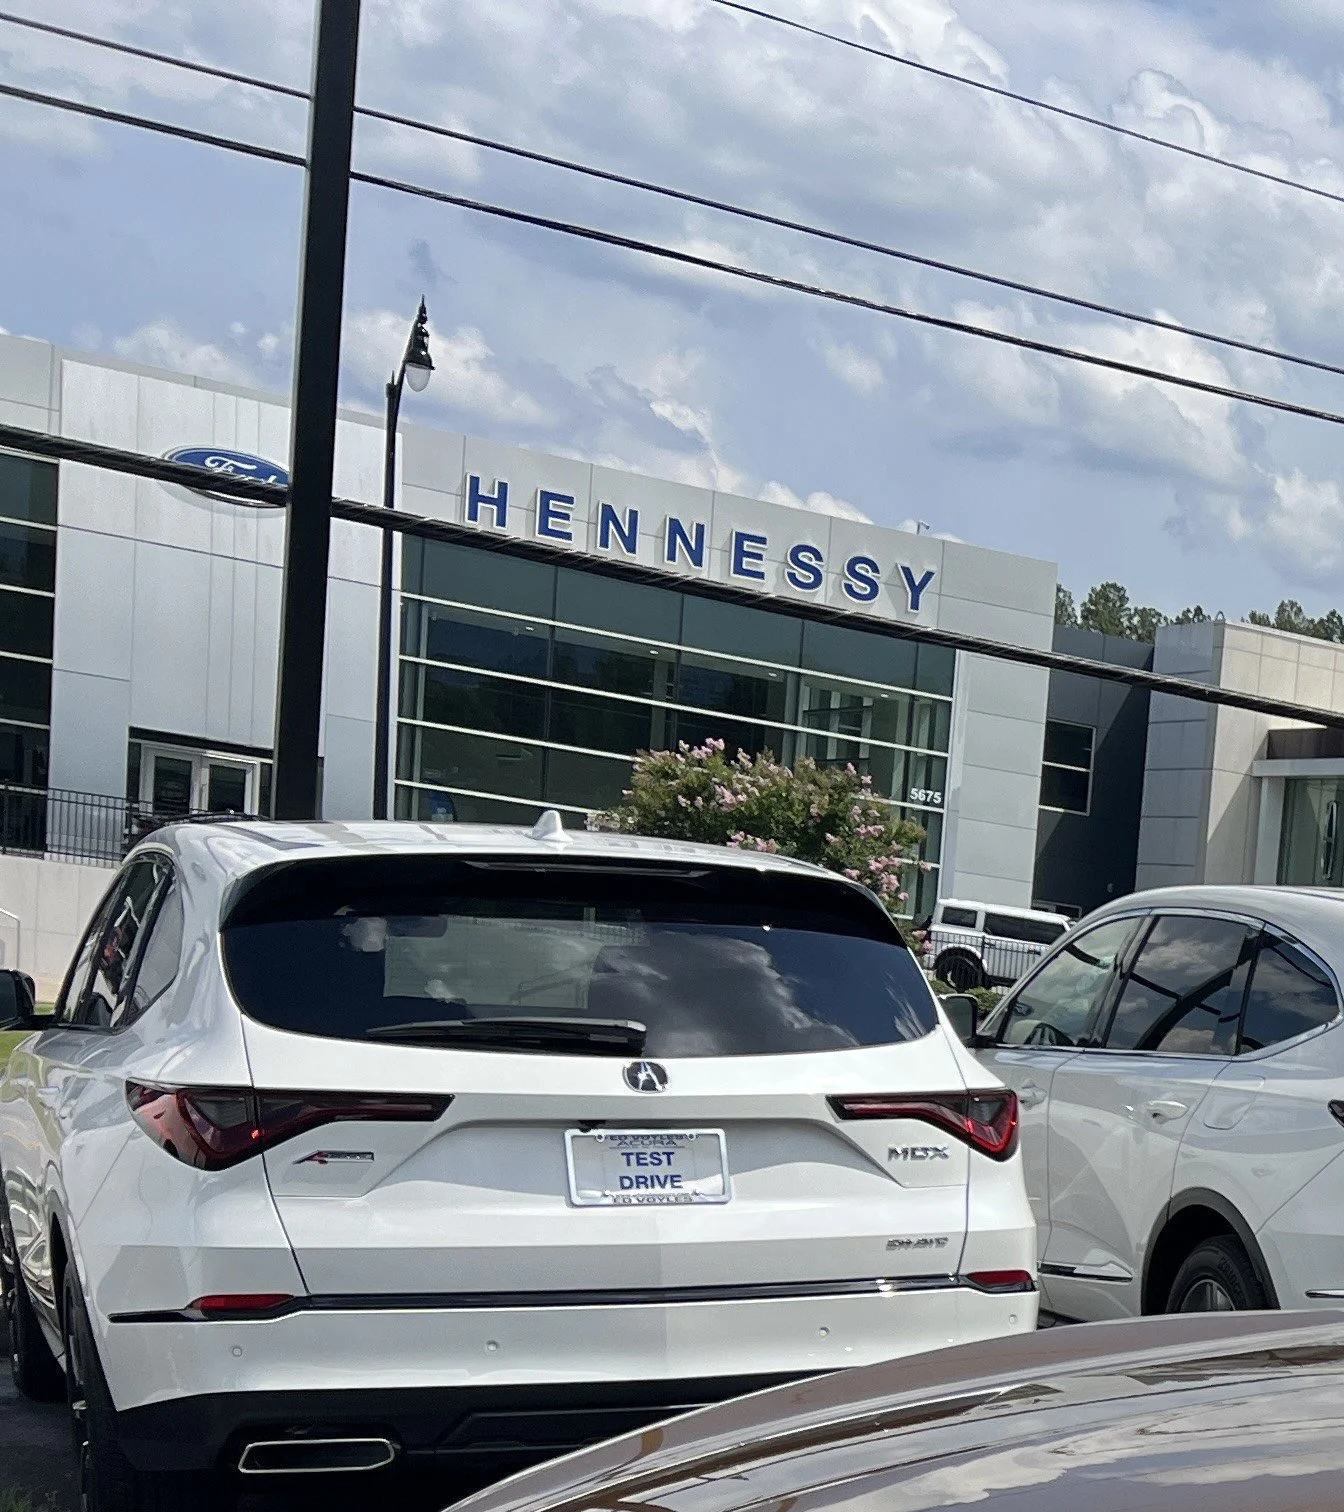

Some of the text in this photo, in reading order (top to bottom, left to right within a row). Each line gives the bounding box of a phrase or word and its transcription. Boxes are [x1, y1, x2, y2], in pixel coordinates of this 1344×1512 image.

[465, 473, 936, 613] HENNESSY
[909, 788, 942, 804] 5675
[621, 1151, 675, 1167] TEST
[887, 1146, 950, 1161] MDX
[619, 1174, 684, 1190] DRIVE
